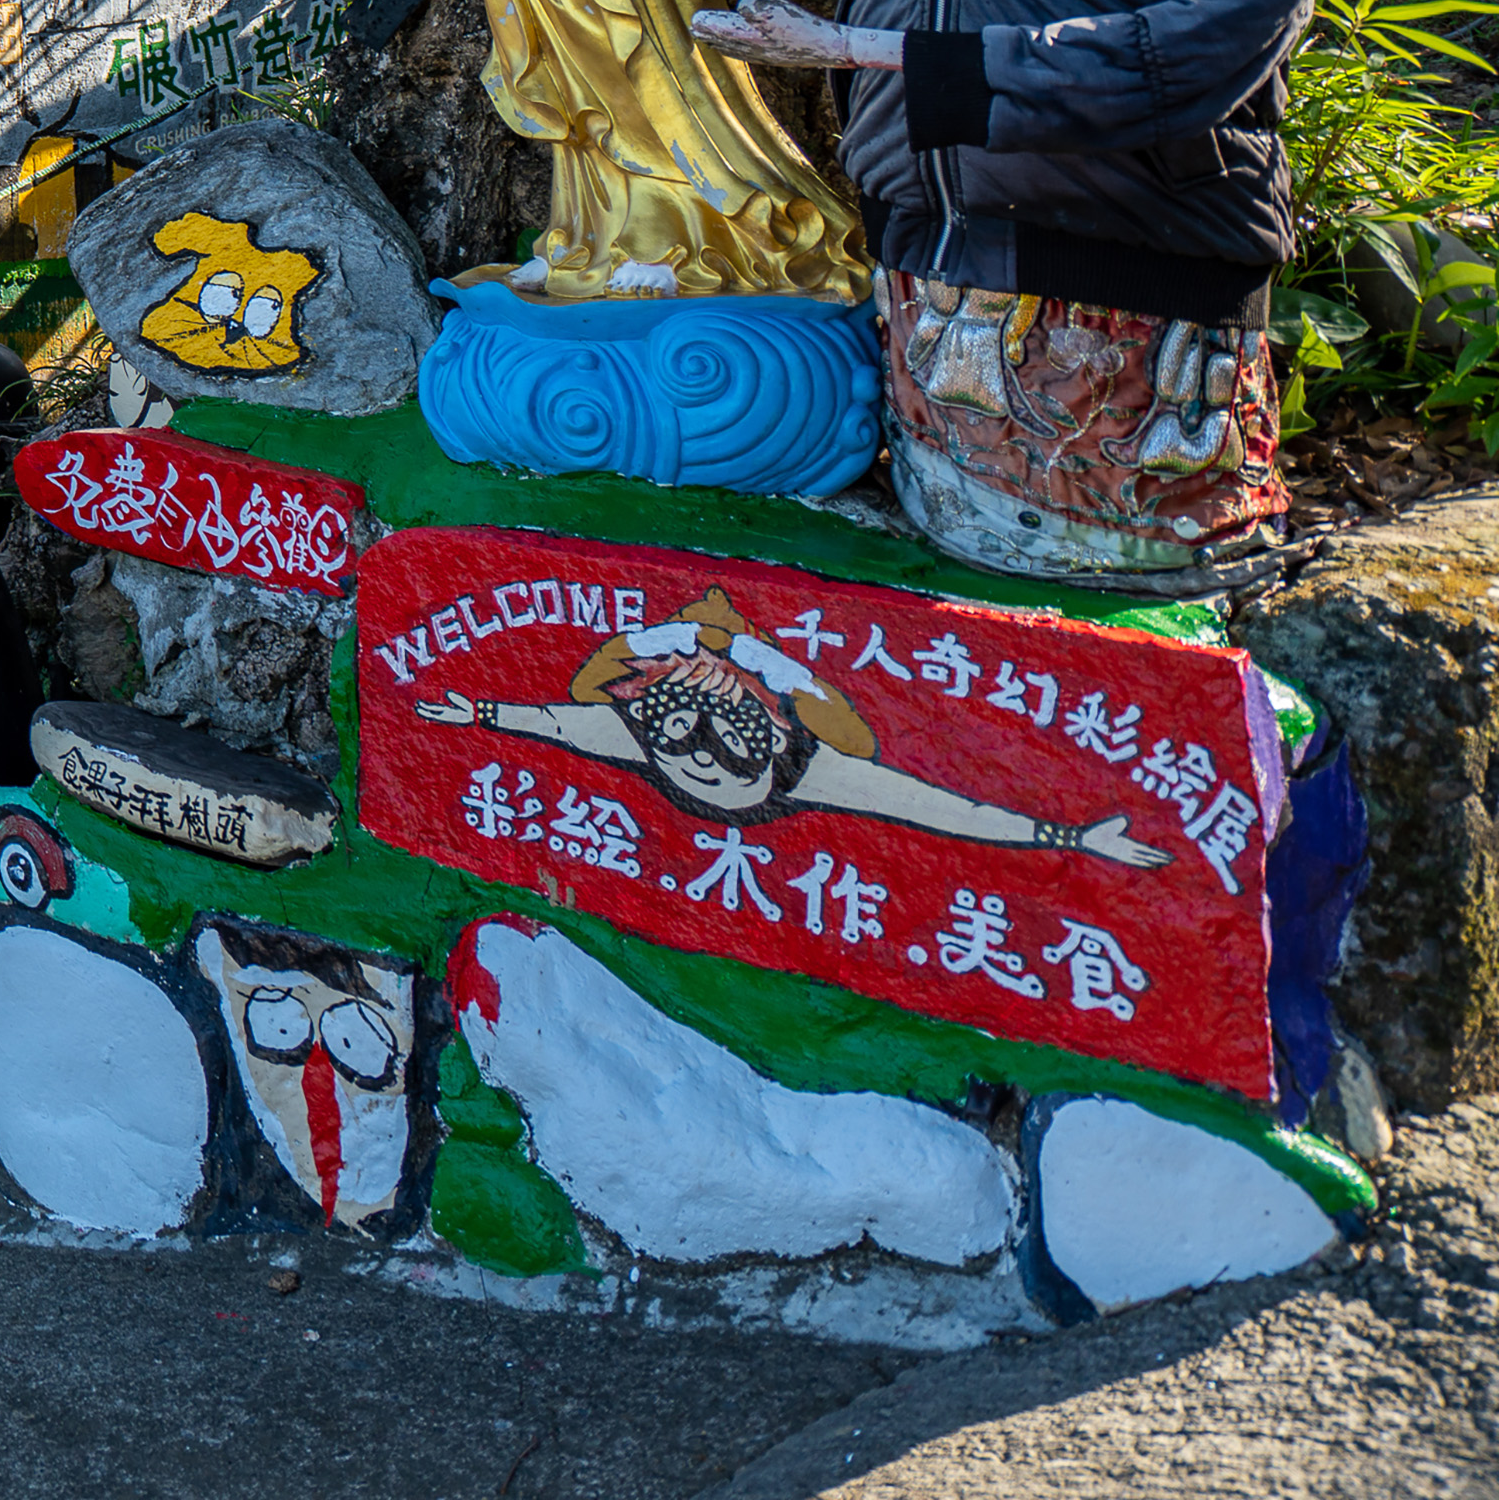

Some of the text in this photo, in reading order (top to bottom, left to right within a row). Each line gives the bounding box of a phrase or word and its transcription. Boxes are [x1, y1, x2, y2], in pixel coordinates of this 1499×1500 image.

[135, 119, 211, 155] CRUSHING
[373, 577, 646, 685] WELCOME
[58, 746, 254, 852] 食果子拜樹頭
